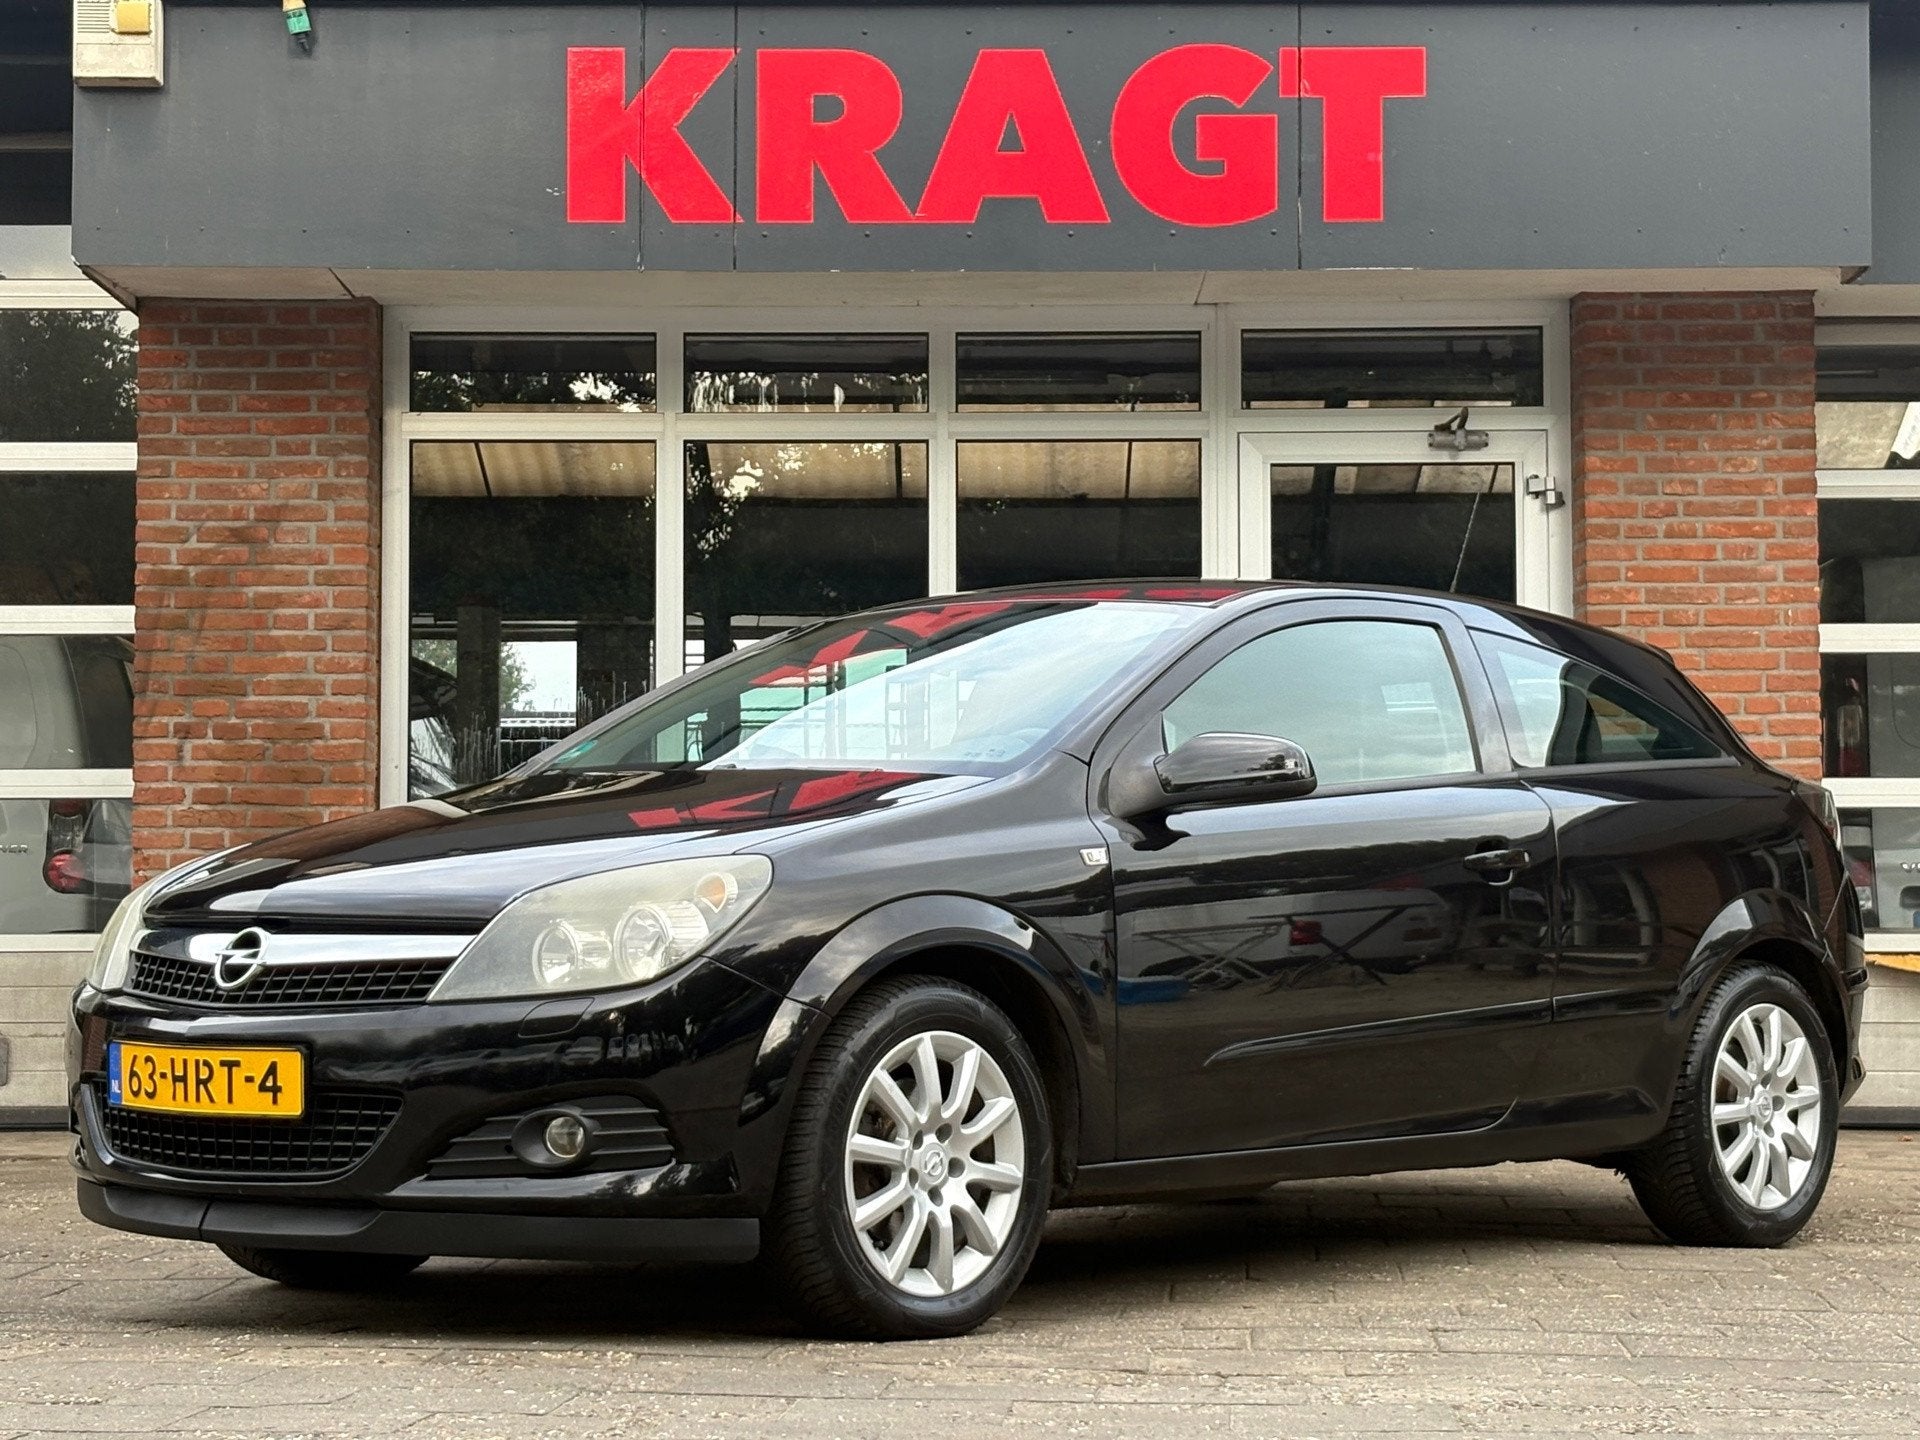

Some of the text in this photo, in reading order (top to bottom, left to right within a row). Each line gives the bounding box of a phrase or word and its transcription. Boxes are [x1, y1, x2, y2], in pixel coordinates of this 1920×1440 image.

[566, 44, 1427, 228] KRAGT
[111, 1079, 122, 1094] NL
[128, 1054, 283, 1106] 63-HRT-4
